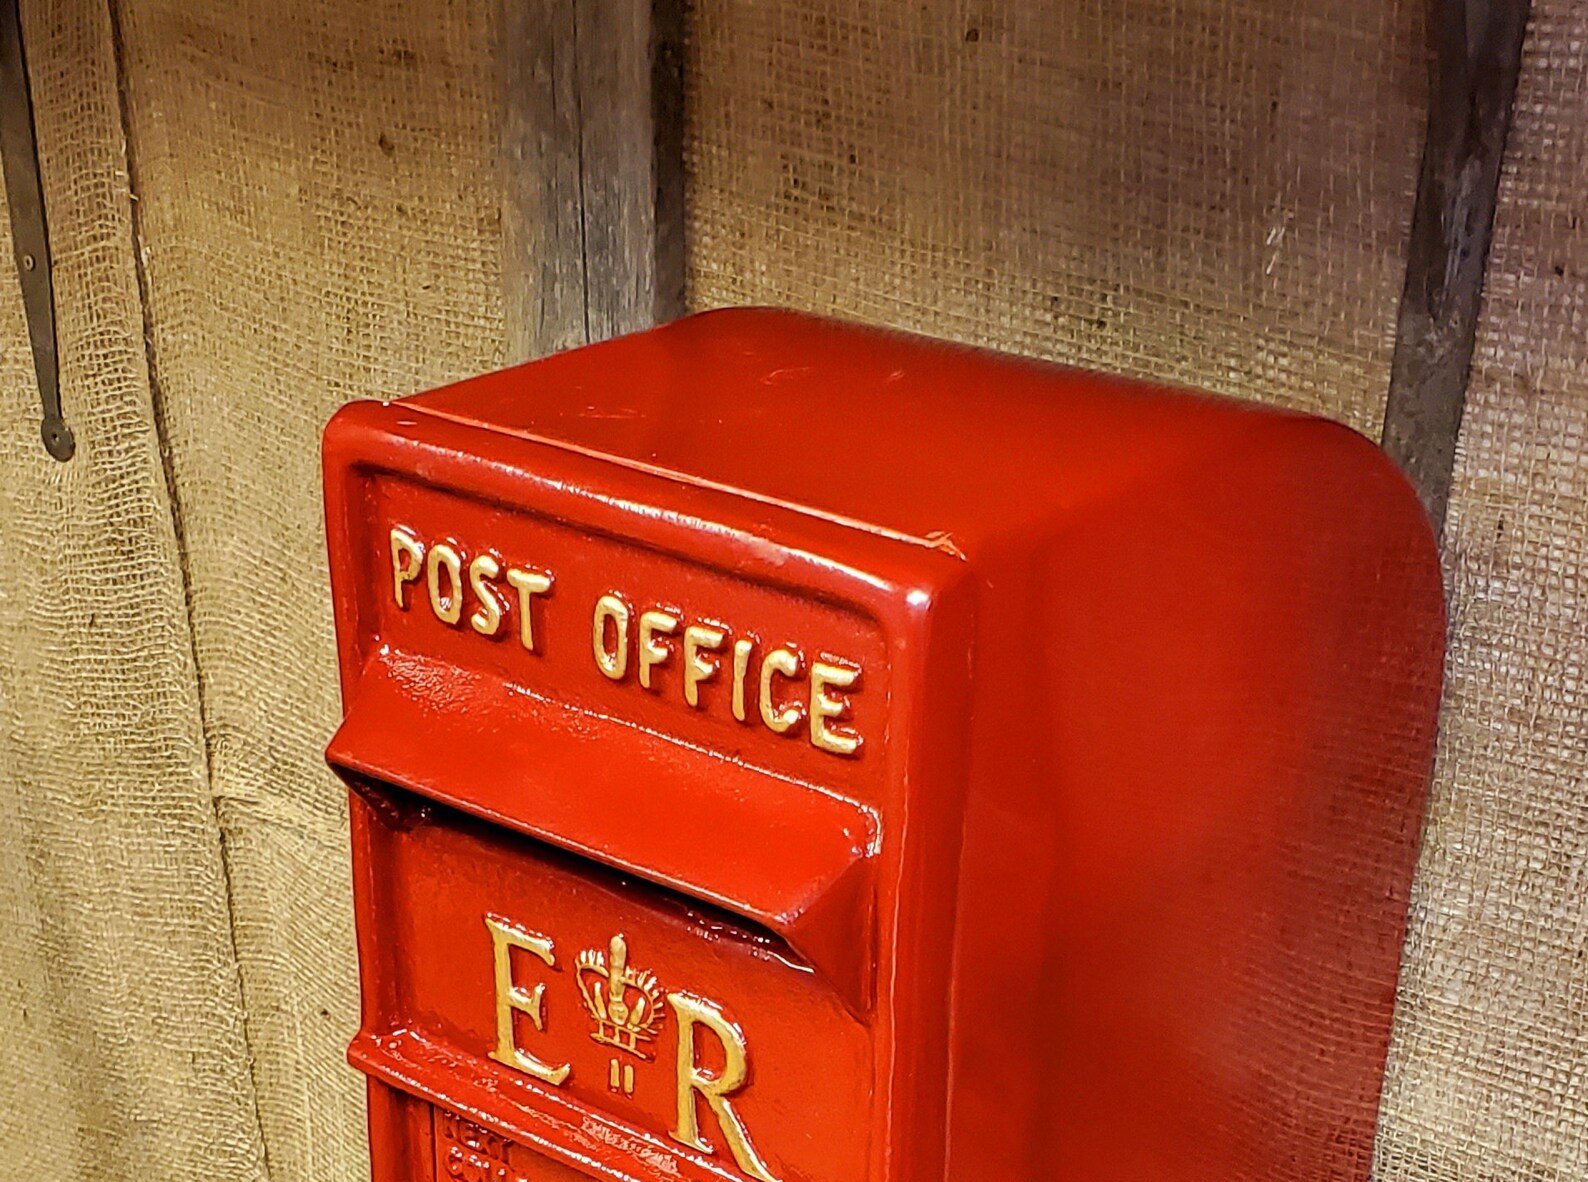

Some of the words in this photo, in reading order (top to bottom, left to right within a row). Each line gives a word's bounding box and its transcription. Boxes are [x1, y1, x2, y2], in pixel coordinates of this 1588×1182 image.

[390, 526, 552, 651] POST
[593, 593, 862, 755] OFFICE
[485, 913, 570, 1086] E
